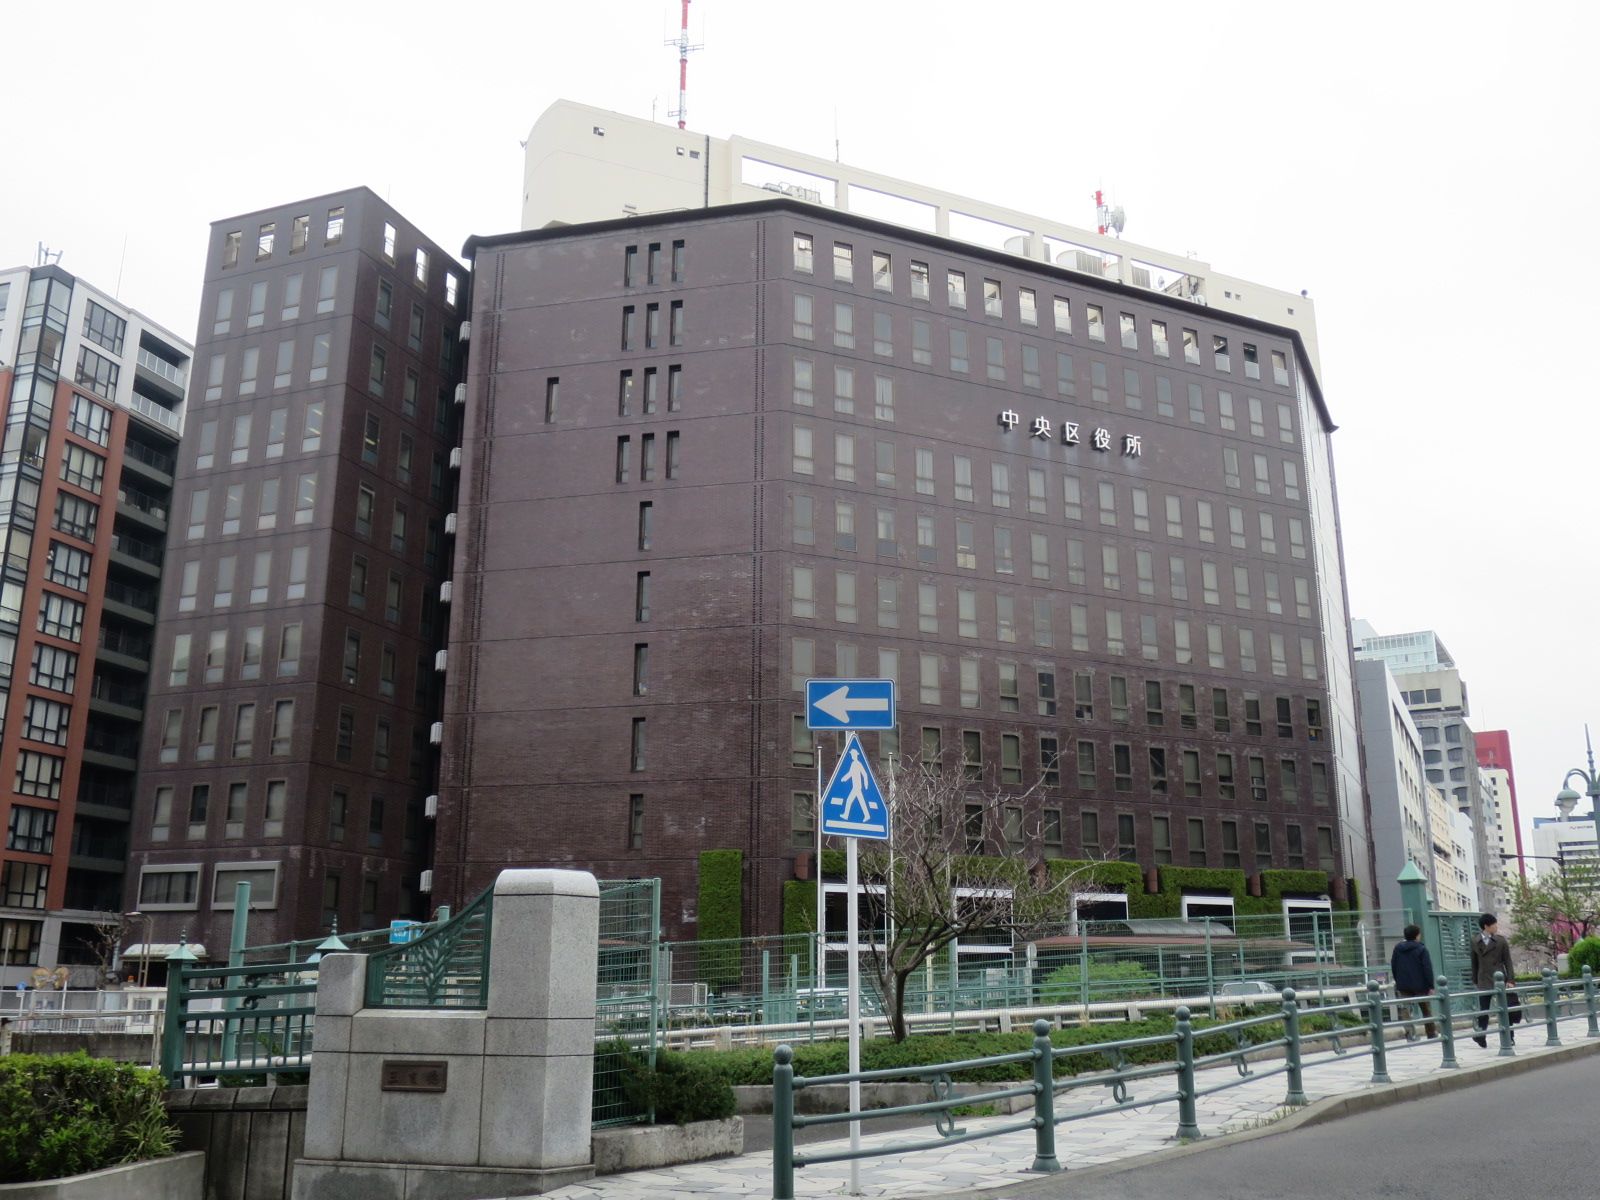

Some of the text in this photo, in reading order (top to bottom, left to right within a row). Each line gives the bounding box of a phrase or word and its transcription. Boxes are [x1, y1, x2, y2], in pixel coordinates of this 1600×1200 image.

[1002, 409, 1142, 456] 中央区役所
